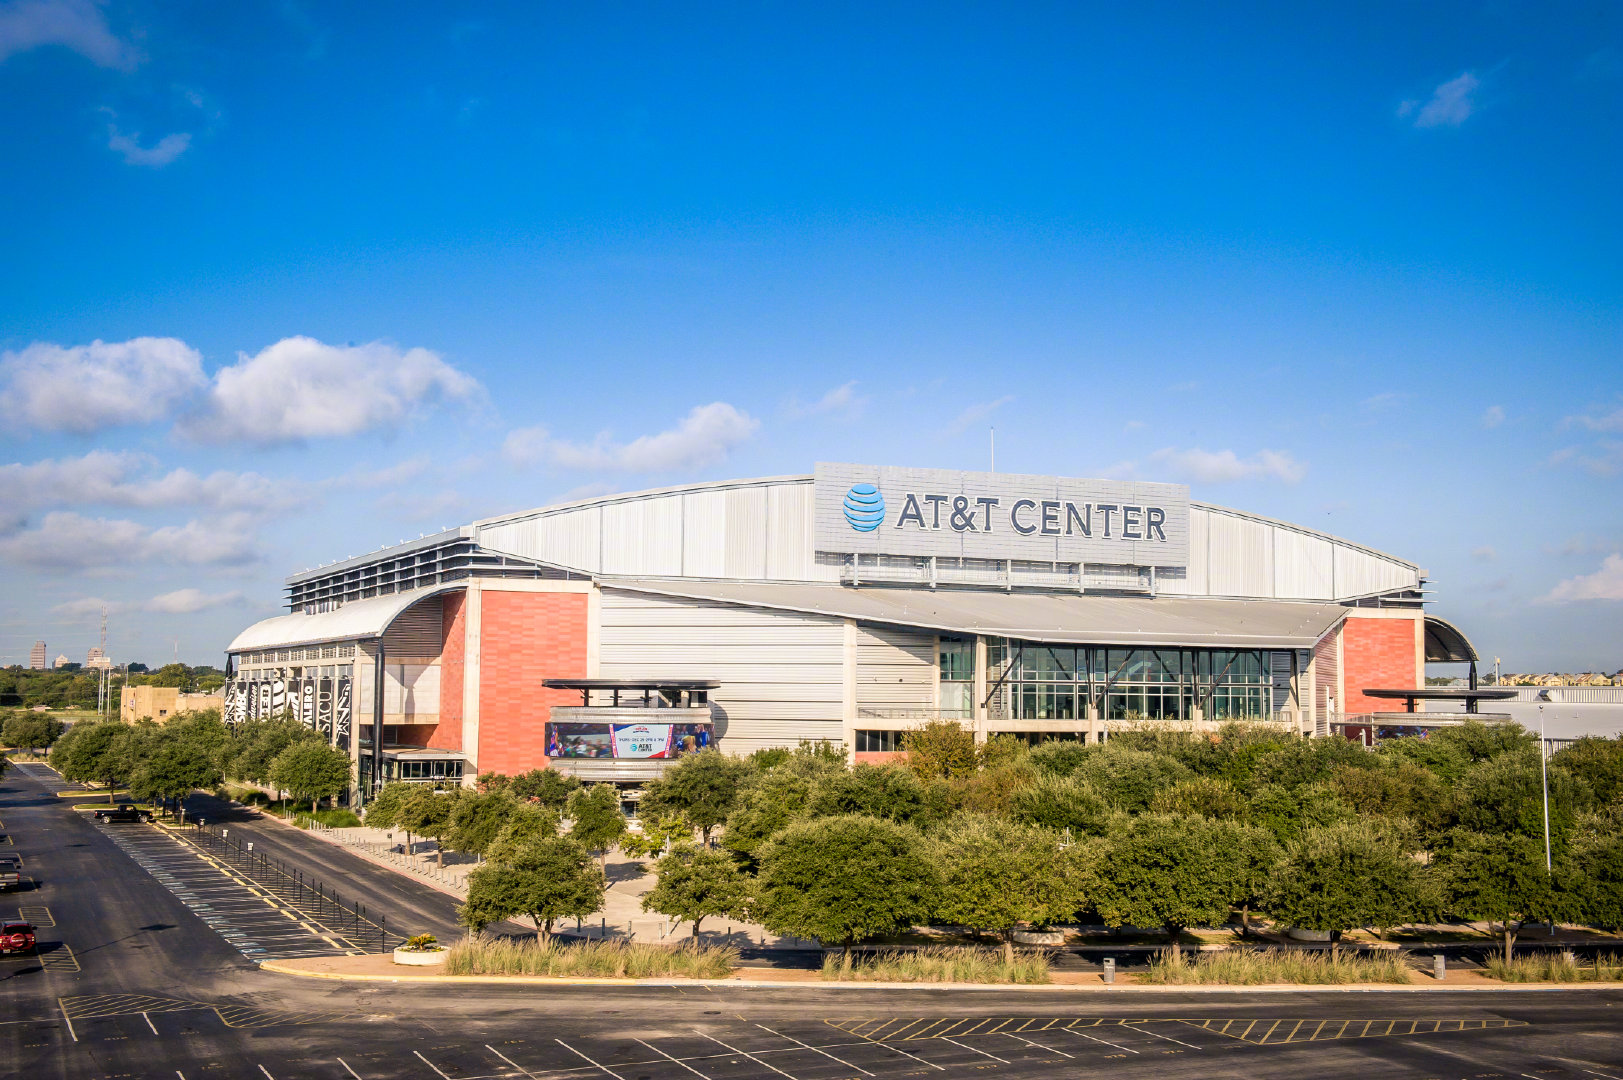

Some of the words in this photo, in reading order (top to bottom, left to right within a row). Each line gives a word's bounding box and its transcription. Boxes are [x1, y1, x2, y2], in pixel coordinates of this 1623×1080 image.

[894, 492, 1000, 533] AT&T
[1009, 498, 1168, 542] CENTER
[236, 689, 247, 723] SWBC
[303, 686, 313, 731] VALERO
[320, 691, 332, 732] SACU
